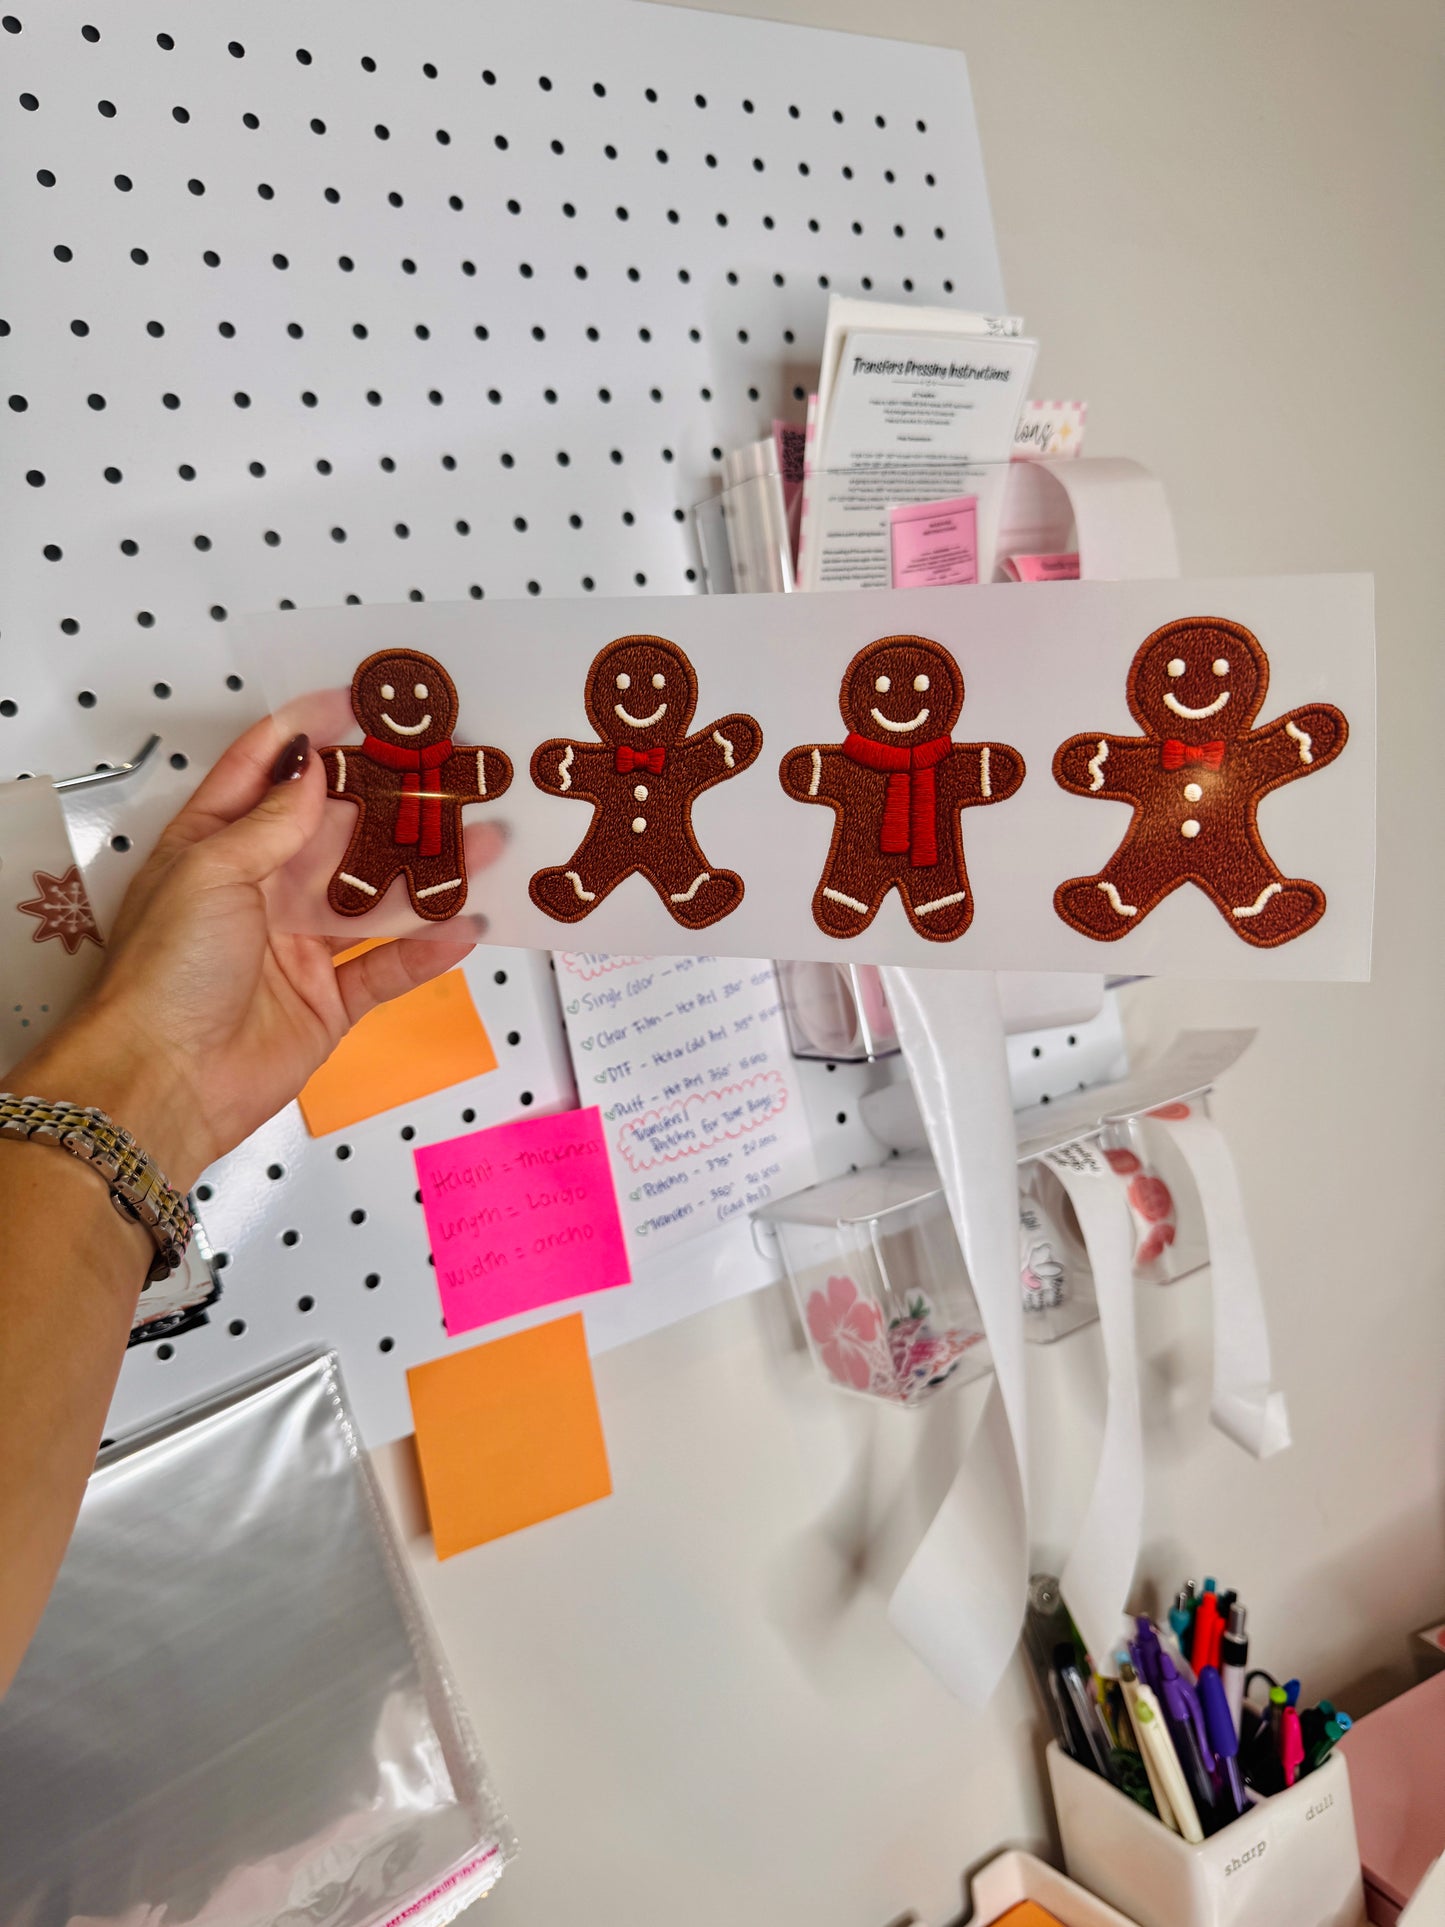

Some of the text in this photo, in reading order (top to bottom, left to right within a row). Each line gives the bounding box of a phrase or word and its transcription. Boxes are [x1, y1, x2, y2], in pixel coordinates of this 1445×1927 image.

[853, 357, 1011, 383] Transfers Pressing Instructions
[582, 988, 622, 1011] Single
[626, 974, 654, 996] Color
[596, 1027, 627, 1048] Clear
[607, 1060, 632, 1083] DTF
[614, 1095, 645, 1117] Puff
[650, 1128, 697, 1153] Patches
[431, 1158, 492, 1197] Height
[642, 1172, 689, 1197] Patches
[526, 1186, 587, 1209] Largo
[534, 1223, 594, 1253] ancho
[1305, 1793, 1334, 1821] dull
[1225, 1840, 1267, 1876] sharp
